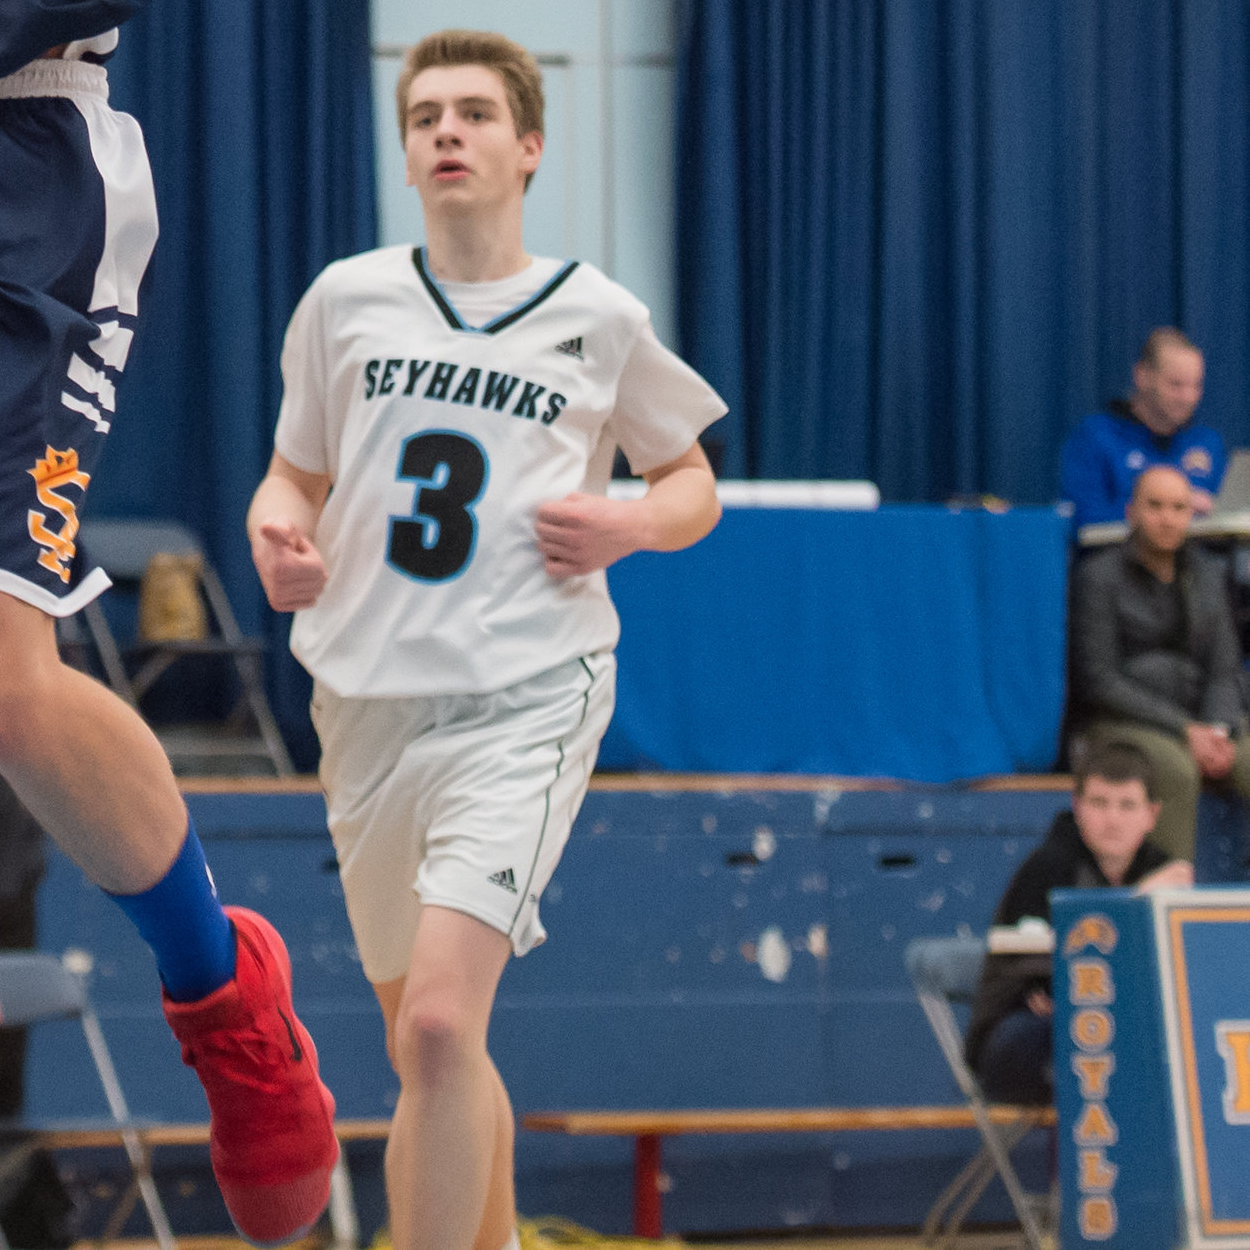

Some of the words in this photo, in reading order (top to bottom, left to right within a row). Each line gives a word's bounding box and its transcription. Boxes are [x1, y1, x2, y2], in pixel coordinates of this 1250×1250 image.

[364, 358, 568, 427] SEYHAWKS
[384, 428, 491, 586] 3
[1068, 956, 1119, 1242] ROYALS
